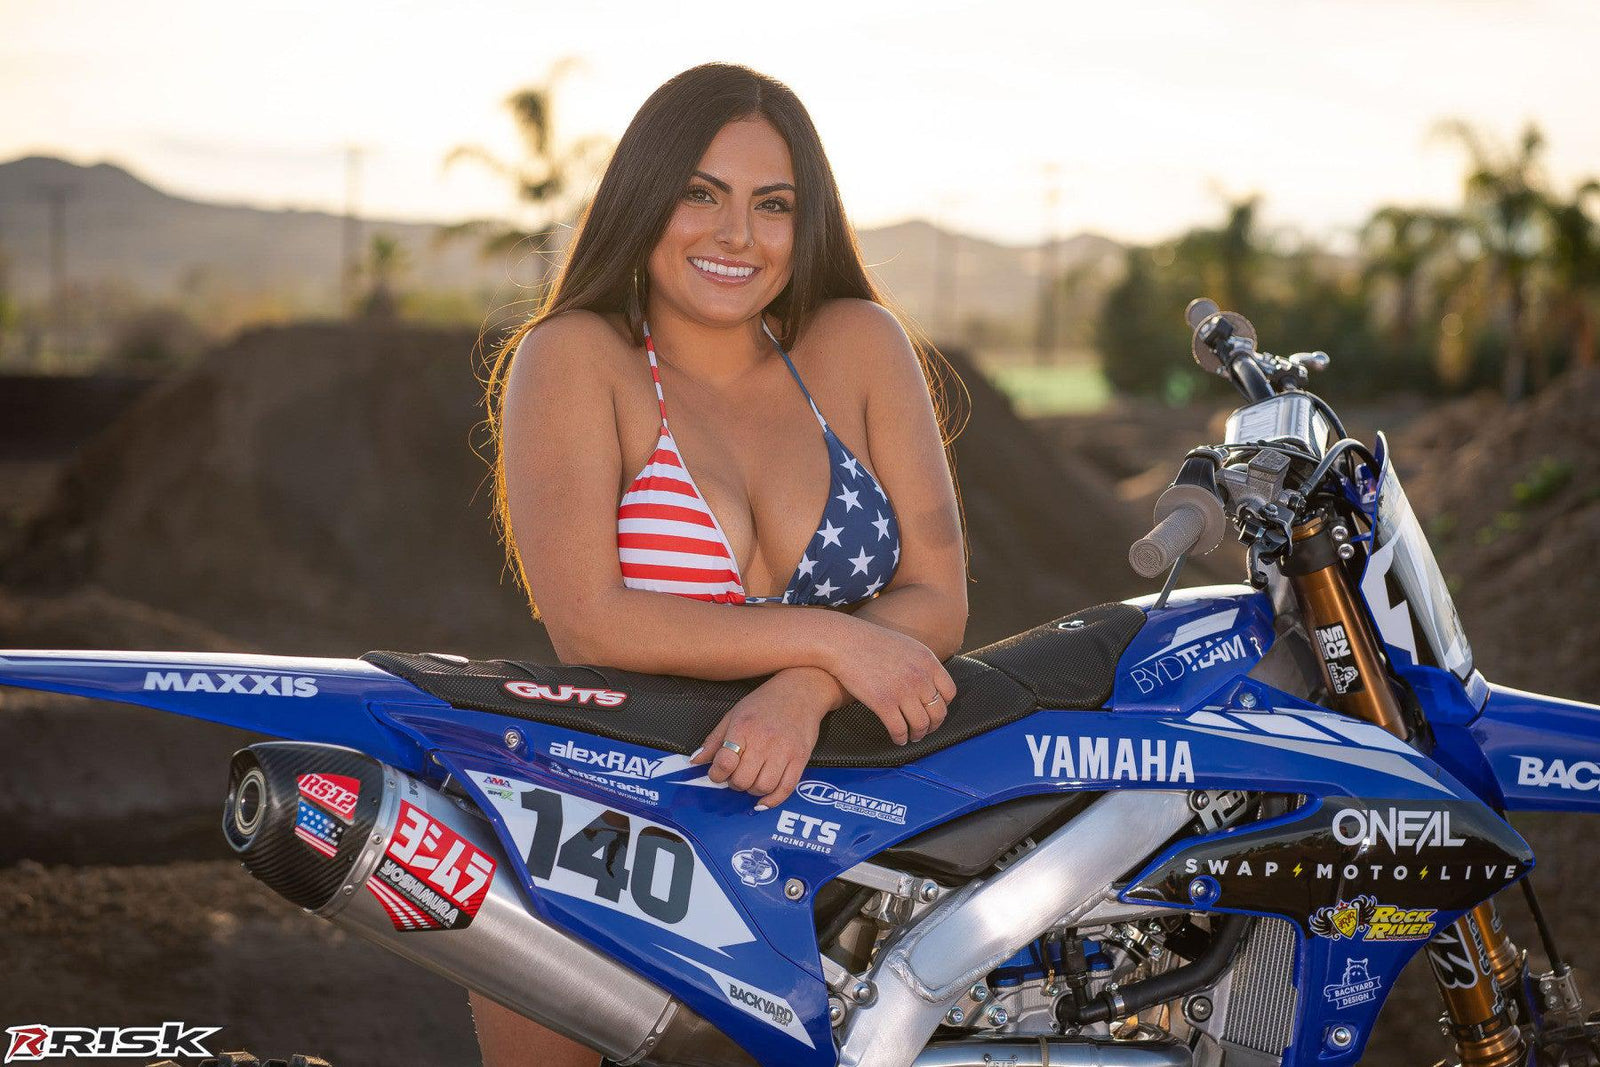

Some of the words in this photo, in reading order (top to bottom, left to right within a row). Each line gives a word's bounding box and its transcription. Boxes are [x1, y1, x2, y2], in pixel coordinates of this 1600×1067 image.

[143, 671, 319, 698] MAXXIS
[504, 681, 627, 707] GUTS
[1025, 734, 1195, 784] YAMAHA
[483, 776, 513, 790] AMA
[567, 767, 609, 785] enzo
[609, 779, 660, 802] racing
[1508, 754, 1600, 792] BAC
[827, 790, 905, 818] MAXIMA
[776, 810, 842, 846] ETS
[388, 807, 494, 904] ヨシムラ
[521, 787, 695, 925] 140
[771, 833, 804, 849] RACING
[806, 842, 832, 855] FUELS
[1184, 858, 1279, 877] SWAP
[1316, 863, 1409, 881] MOTO
[1440, 864, 1517, 881] LIVE
[380, 859, 460, 925] YOSHIMURA
[1369, 906, 1434, 924] ROCK
[1364, 922, 1435, 940] RIVER
[727, 982, 794, 1024] BACKYARD
[1334, 981, 1375, 998] BACKYARD
[1342, 993, 1370, 1007] DESIGN
